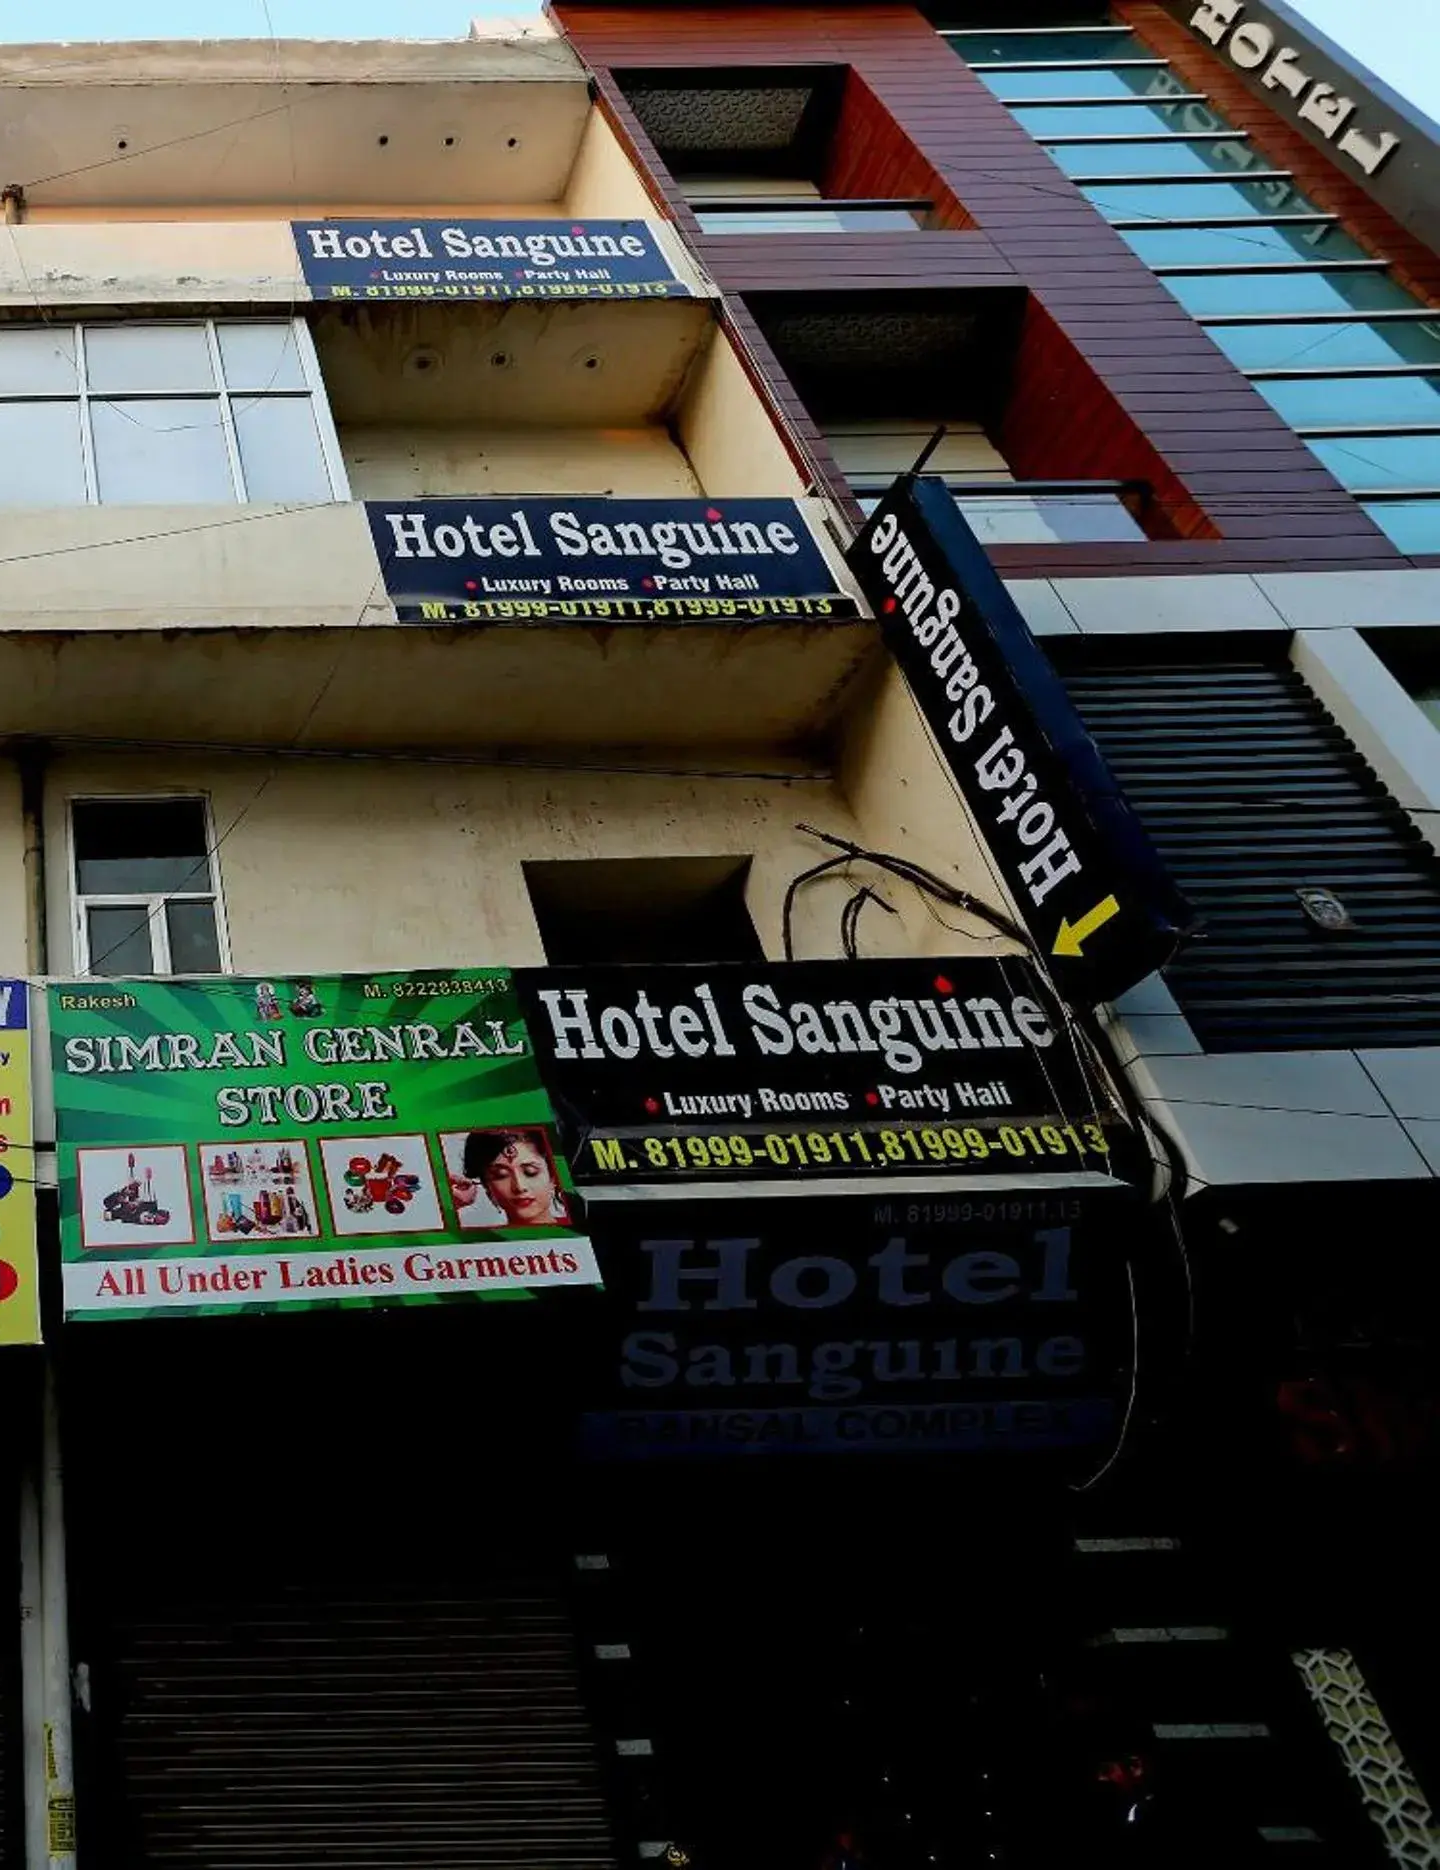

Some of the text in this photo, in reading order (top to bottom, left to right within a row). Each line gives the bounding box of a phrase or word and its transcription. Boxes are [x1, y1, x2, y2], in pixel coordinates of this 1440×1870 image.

[1190, 0, 1400, 175] HOTEL
[306, 226, 645, 265] Hotel Sanguine
[331, 285, 359, 297] M.
[382, 268, 610, 282] Luxury Rooms Party Hall
[385, 506, 800, 569] Hotel Sanguine
[482, 573, 759, 594] Luxury Rooms Party Hall
[419, 602, 456, 620] M.
[869, 513, 1082, 907] Hotel Sanguine
[61, 993, 137, 1011] Rakesh
[364, 984, 388, 999] M.
[538, 974, 1058, 1074] Hotel Sanguine
[65, 1020, 526, 1075] SIMRAN GENRAL
[216, 1079, 396, 1127] STORE
[663, 1082, 1012, 1118] Luxury Rooms Party Hall
[591, 1139, 638, 1170] M.
[95, 1247, 579, 1297] All Under Ladies Garments
[635, 1227, 1080, 1312] Hotel
[619, 1330, 1087, 1401] Sanguine
